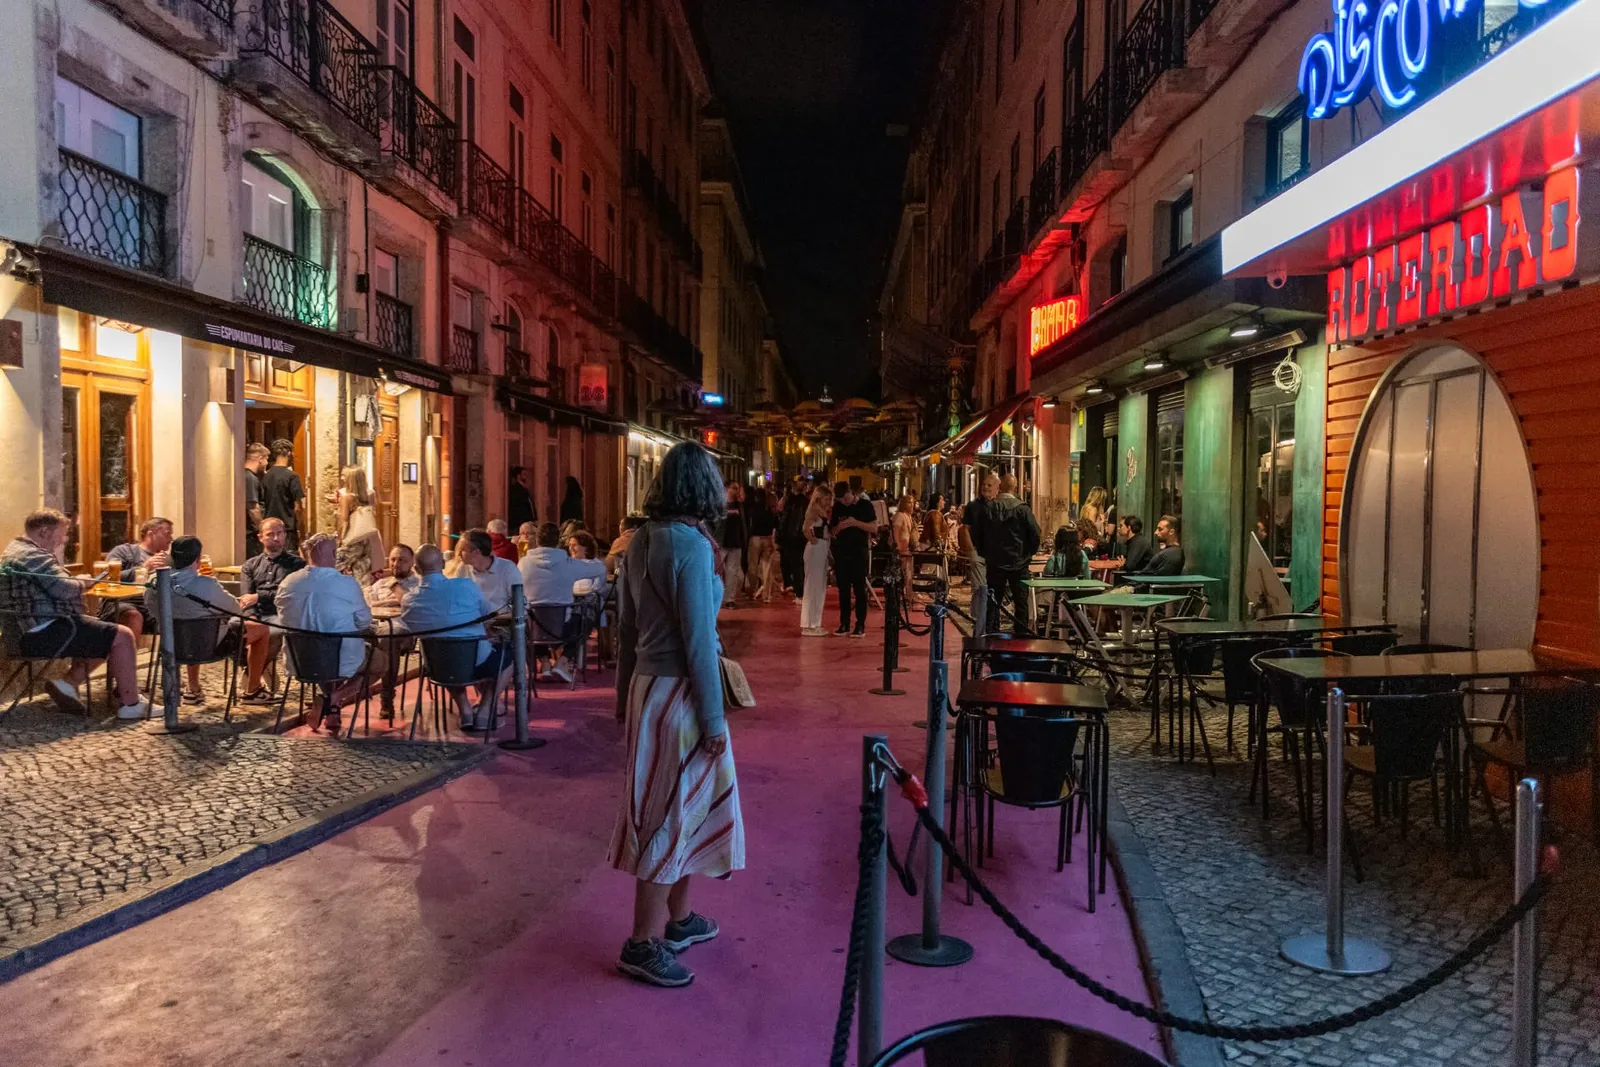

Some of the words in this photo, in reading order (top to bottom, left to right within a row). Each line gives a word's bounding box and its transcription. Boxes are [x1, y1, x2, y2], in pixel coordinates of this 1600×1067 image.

[221, 325, 262, 346] ESPUMANTARIA
[263, 337, 272, 349] DO
[272, 339, 284, 352] CAIS
